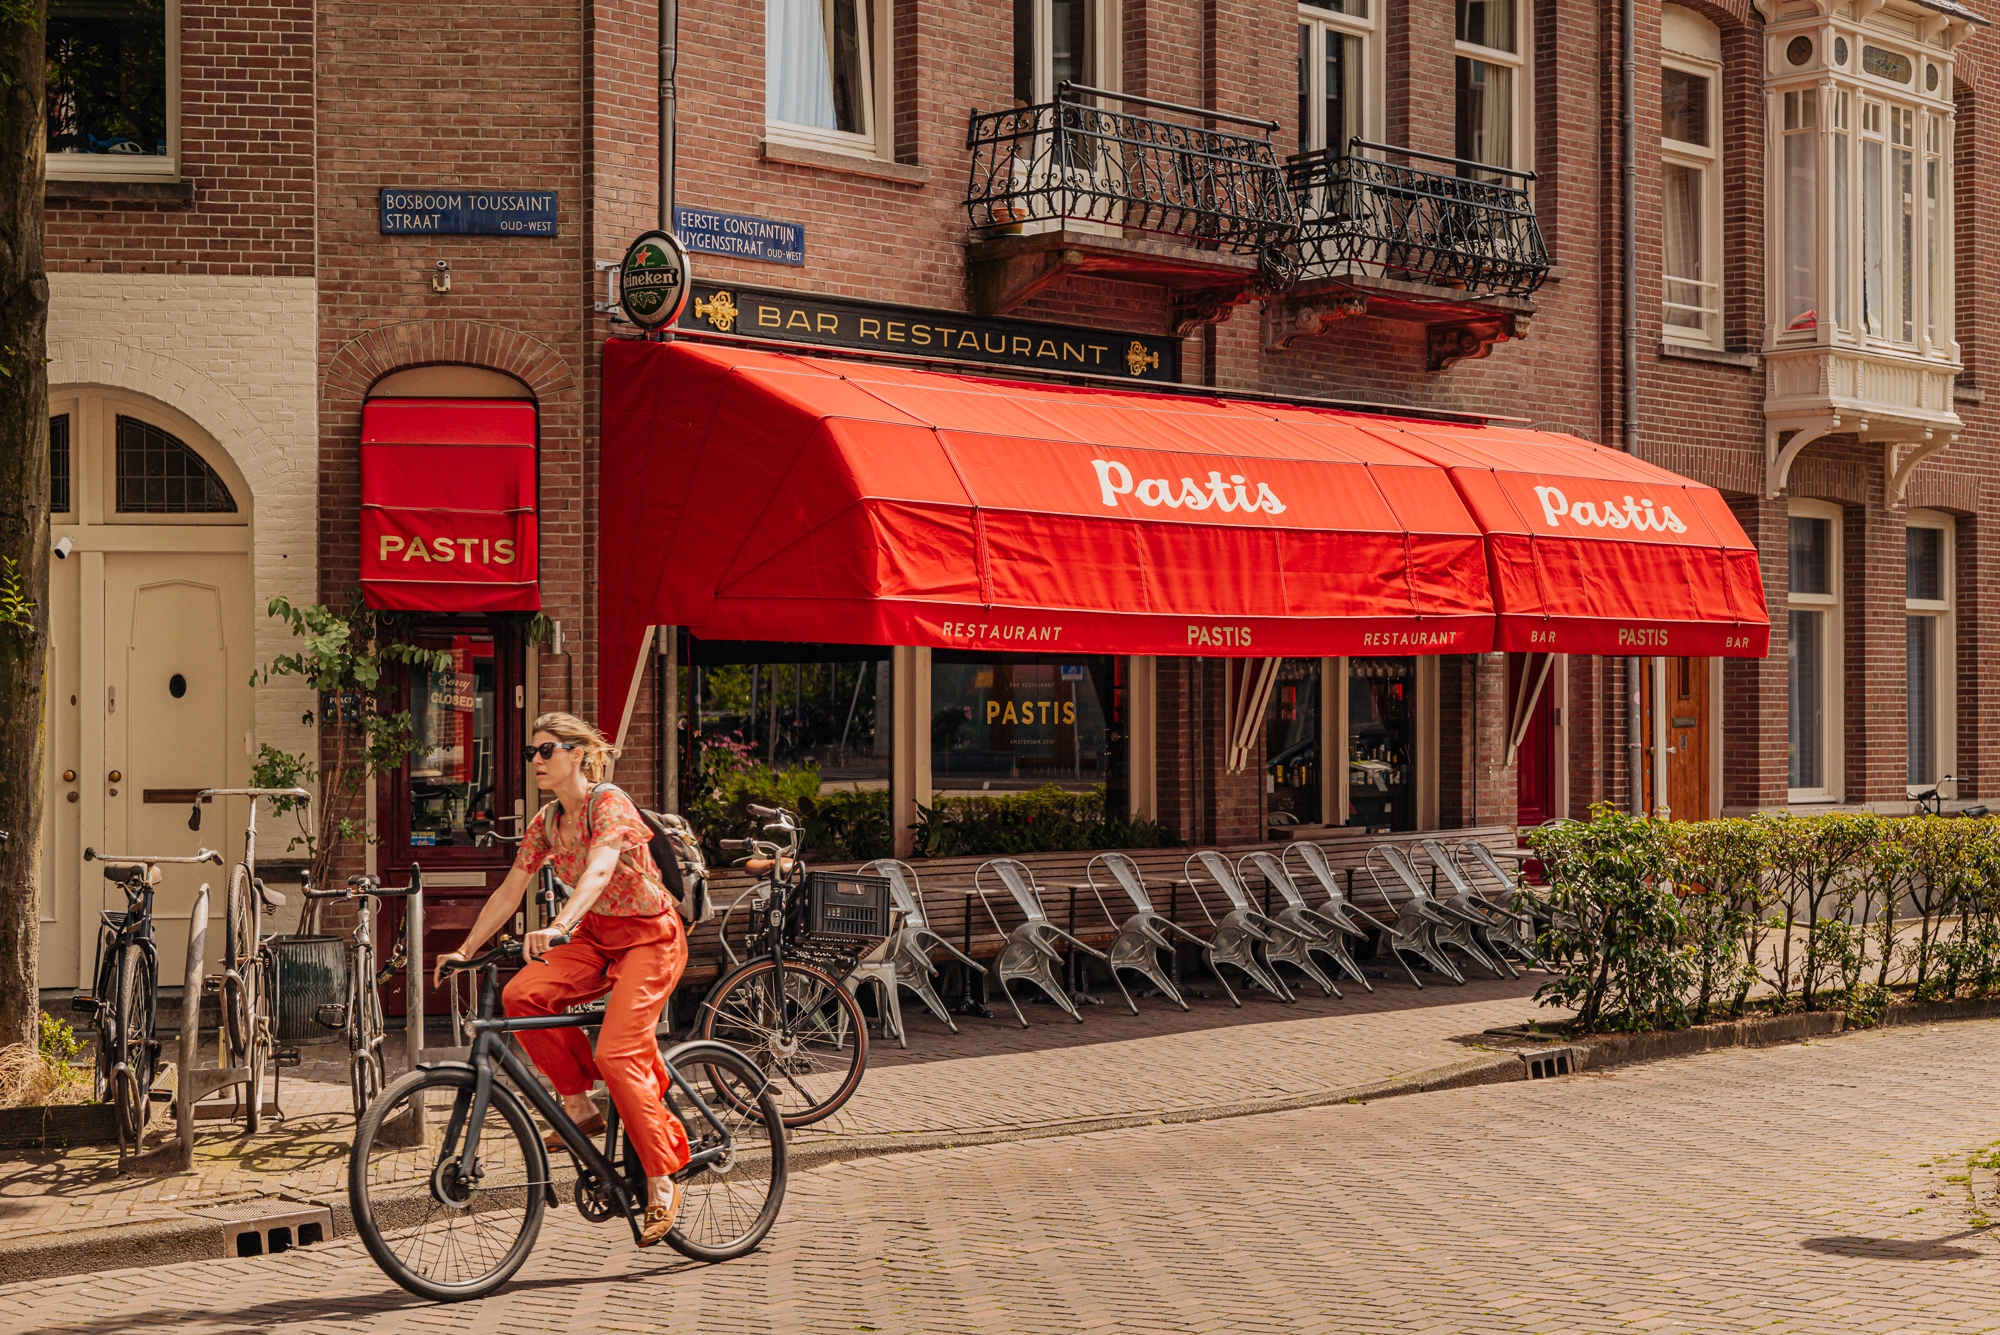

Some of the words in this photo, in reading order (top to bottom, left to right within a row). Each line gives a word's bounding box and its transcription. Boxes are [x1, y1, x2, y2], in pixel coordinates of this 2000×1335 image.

[386, 194, 461, 211] BOSBOOM
[468, 195, 552, 212] TOUSSAINT
[386, 213, 441, 230] STRAAT
[500, 221, 552, 231] OUD-WEST
[681, 211, 720, 231] EERSTE
[723, 218, 795, 245] CONSTANTIJN
[767, 247, 802, 262] OUD-WEST
[625, 271, 674, 288] eineken
[758, 304, 838, 335] BAR
[859, 317, 1108, 364] RESTAURANT
[1090, 459, 1287, 515] Pastis
[1533, 485, 1688, 534] Pastis
[380, 535, 516, 565] PASTIS
[942, 621, 1062, 641] RESTAURANT
[1187, 625, 1252, 647] PASTIS
[1363, 631, 1457, 646] RESTAURANT
[1530, 630, 1556, 643] BAR
[1618, 628, 1669, 646] PASTIS
[1725, 636, 1750, 649] BAR
[438, 674, 471, 692] Sorry
[430, 691, 475, 708] CLOSED
[986, 701, 1076, 725] PASTIS
